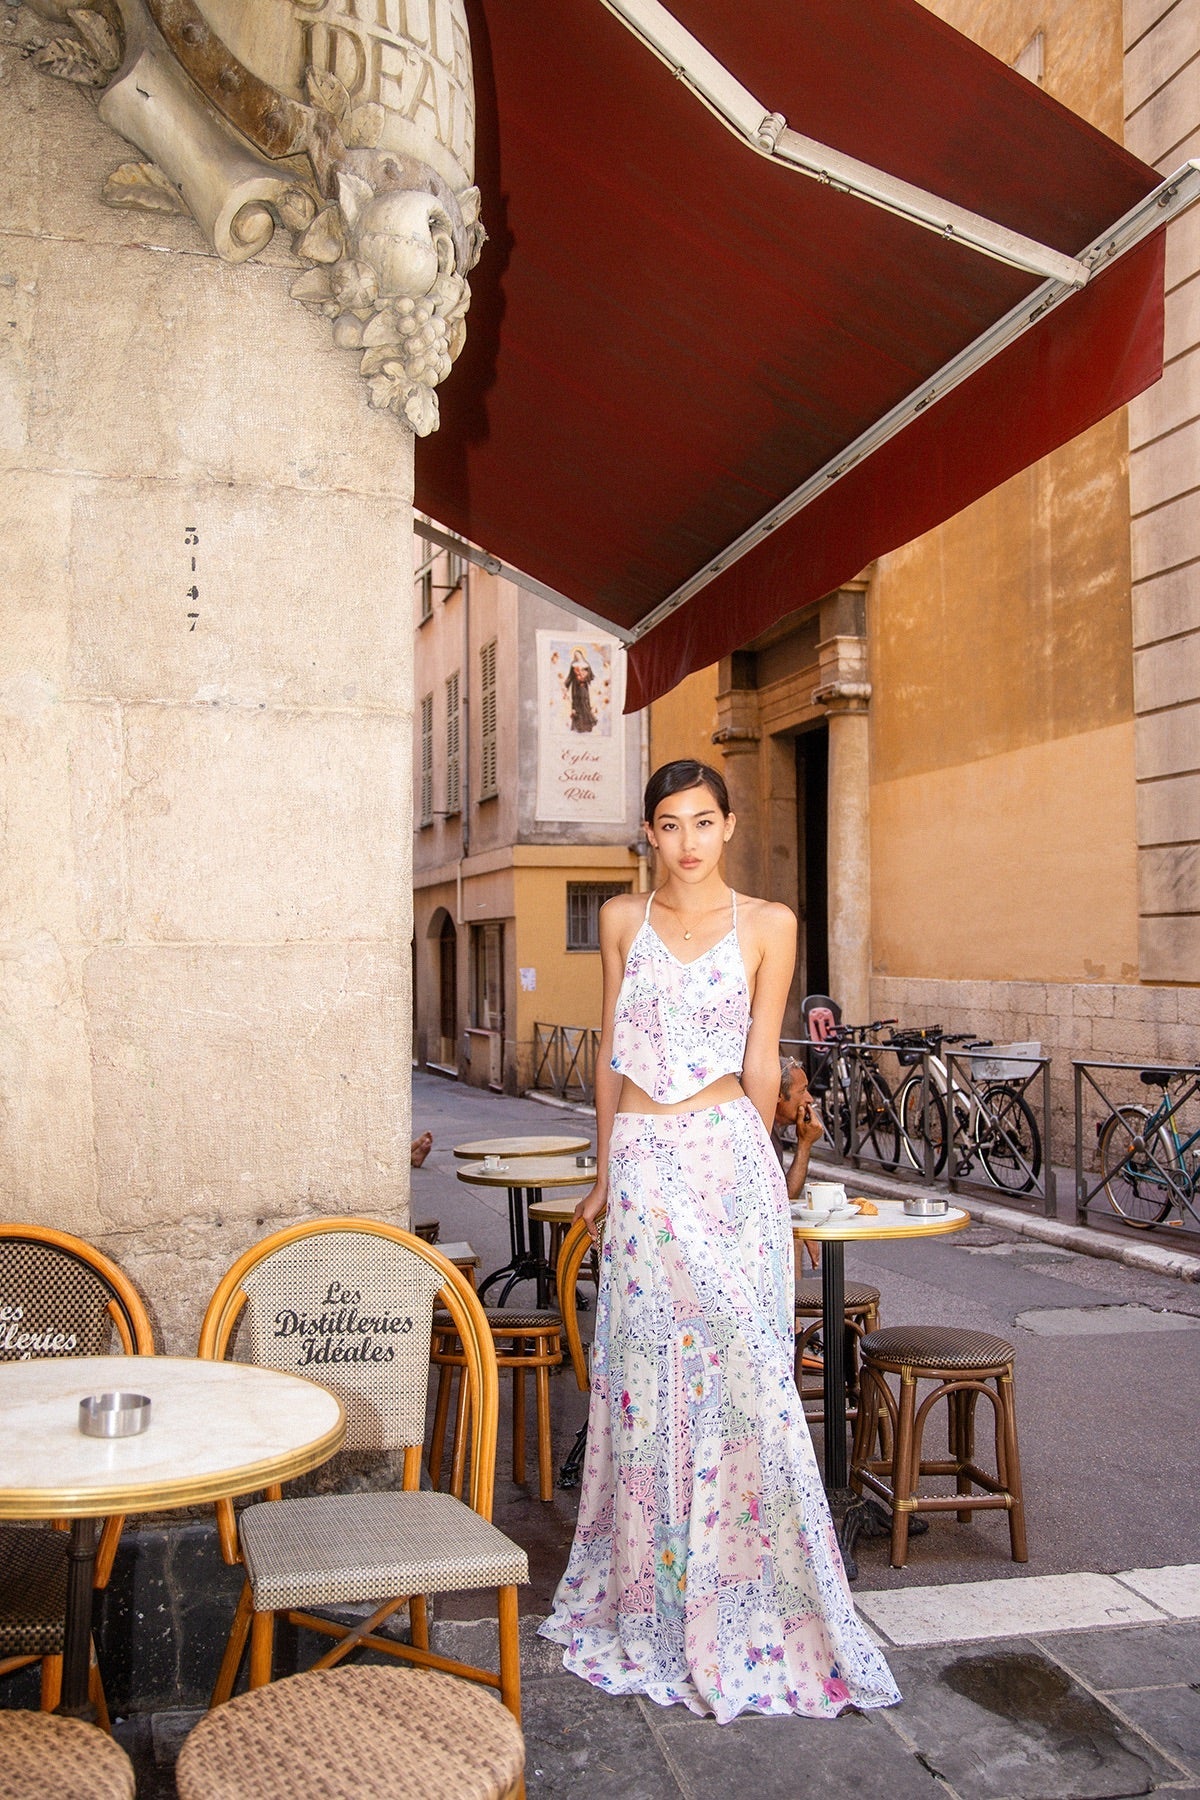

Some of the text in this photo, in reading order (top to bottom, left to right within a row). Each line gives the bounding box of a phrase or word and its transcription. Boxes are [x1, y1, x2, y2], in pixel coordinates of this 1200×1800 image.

[558, 768, 603, 782] Sainte
[563, 786, 596, 801] Rita
[322, 1280, 361, 1305] Les
[0, 1304, 24, 1321] es
[273, 1307, 413, 1337] Distilleries
[297, 1336, 395, 1366] Idéales
